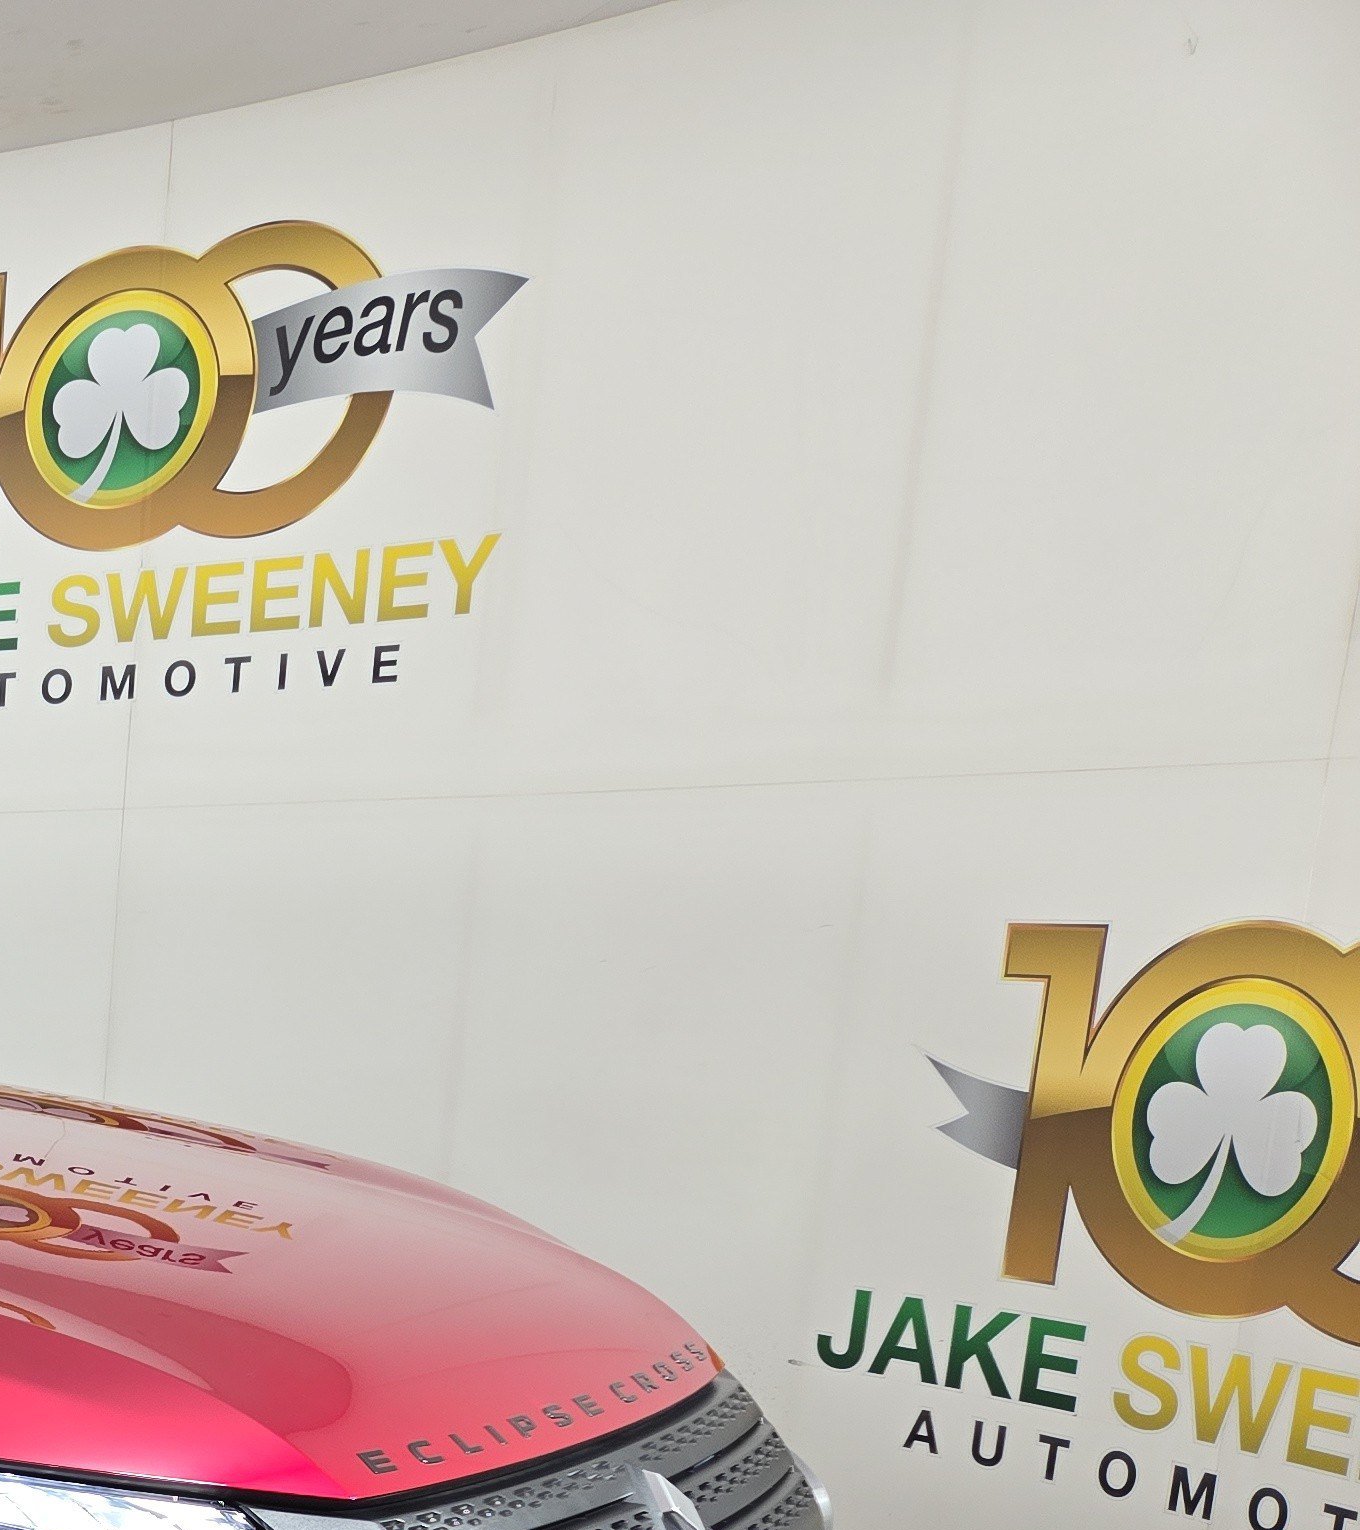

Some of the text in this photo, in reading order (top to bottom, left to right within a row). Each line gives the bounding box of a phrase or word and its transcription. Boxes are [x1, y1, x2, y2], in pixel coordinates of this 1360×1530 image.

[267, 285, 464, 397] years
[46, 533, 502, 648] SWEENEY
[1000, 920, 1360, 1346] 10
[356, 1342, 709, 1475] ECLIPSE CROSS
[815, 1288, 1360, 1480] JAKE SWE
